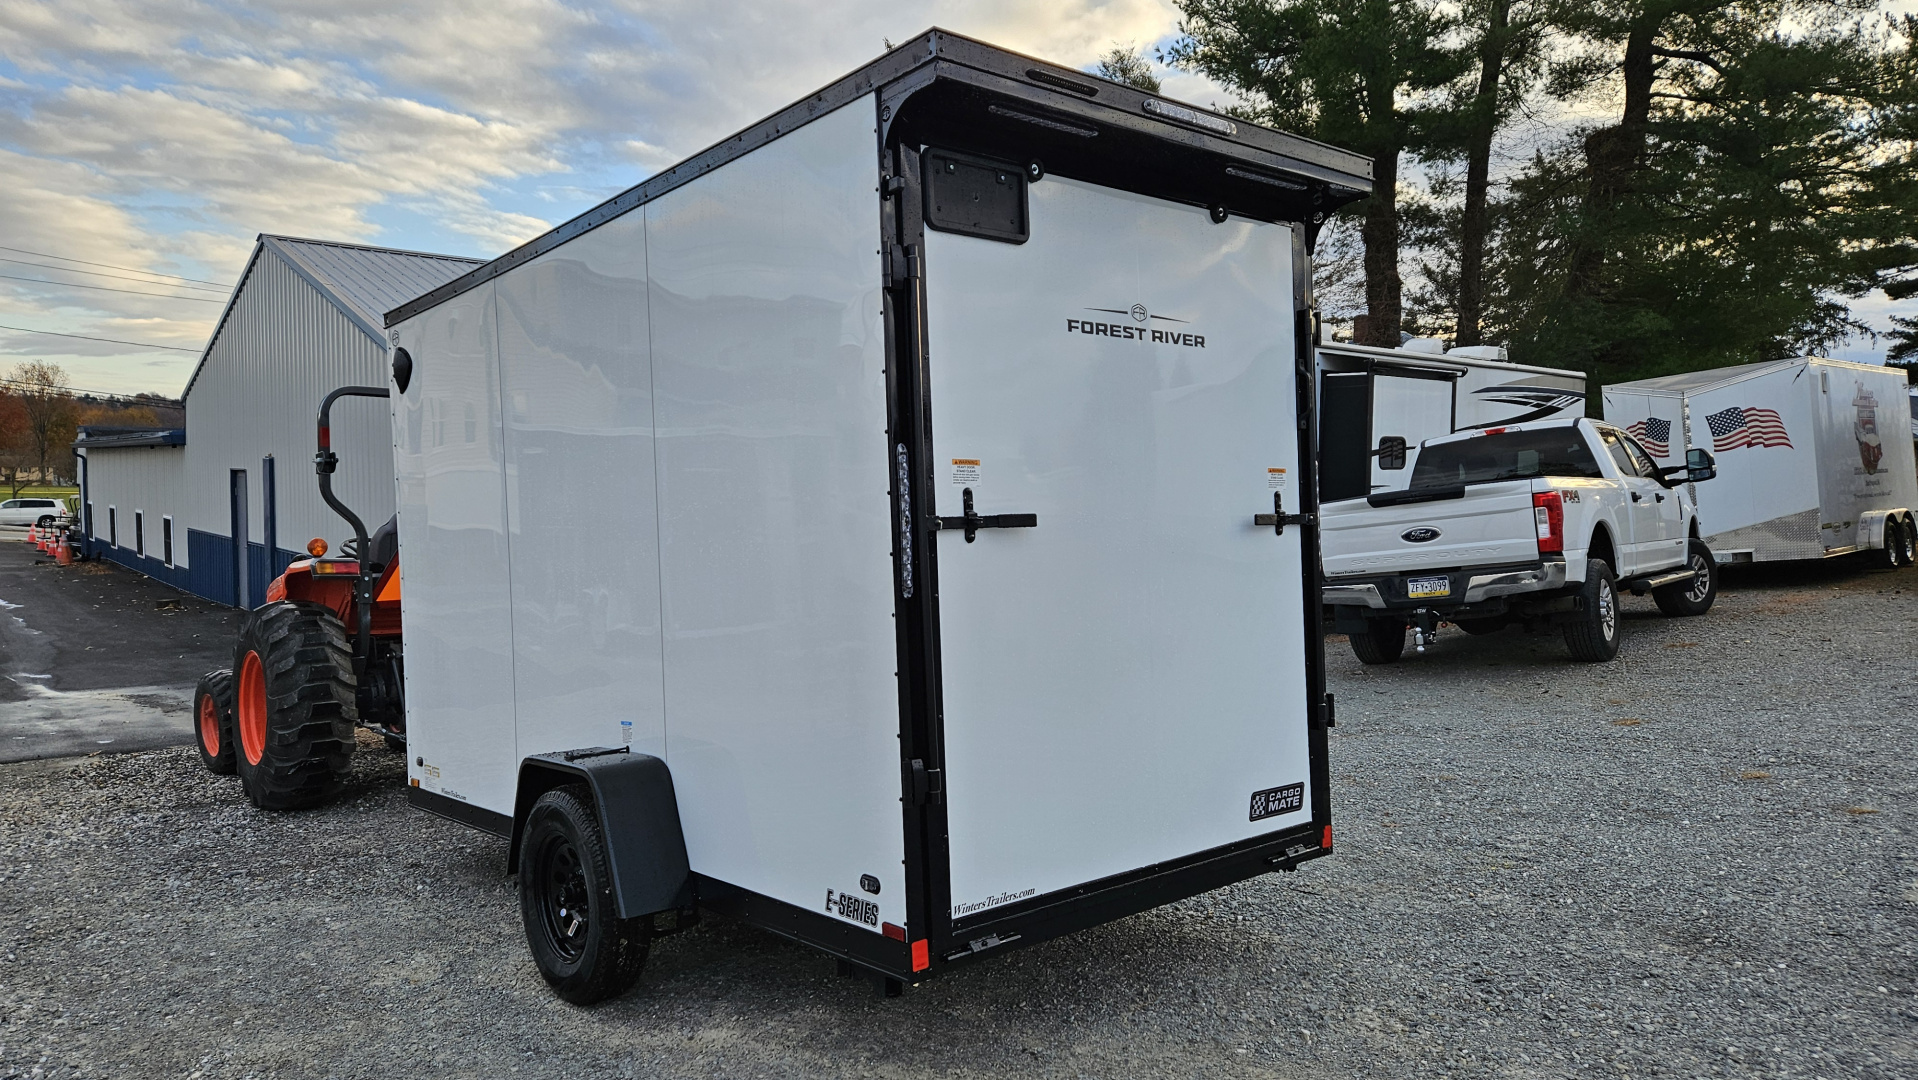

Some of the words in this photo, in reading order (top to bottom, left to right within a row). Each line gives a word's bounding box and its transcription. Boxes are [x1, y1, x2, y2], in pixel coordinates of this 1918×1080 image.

[1066, 318, 1147, 341] FOREST
[1151, 329, 1206, 348] RIVER
[1561, 489, 1580, 503] FX4
[1410, 529, 1432, 540] Ford
[1351, 554, 1430, 566] SUPER
[1436, 547, 1502, 560] DUTY
[1269, 788, 1301, 800] CARGO
[1268, 796, 1300, 812] MATE
[826, 888, 879, 928] E-SERIES
[953, 887, 1036, 916] WintersTrailers.com
